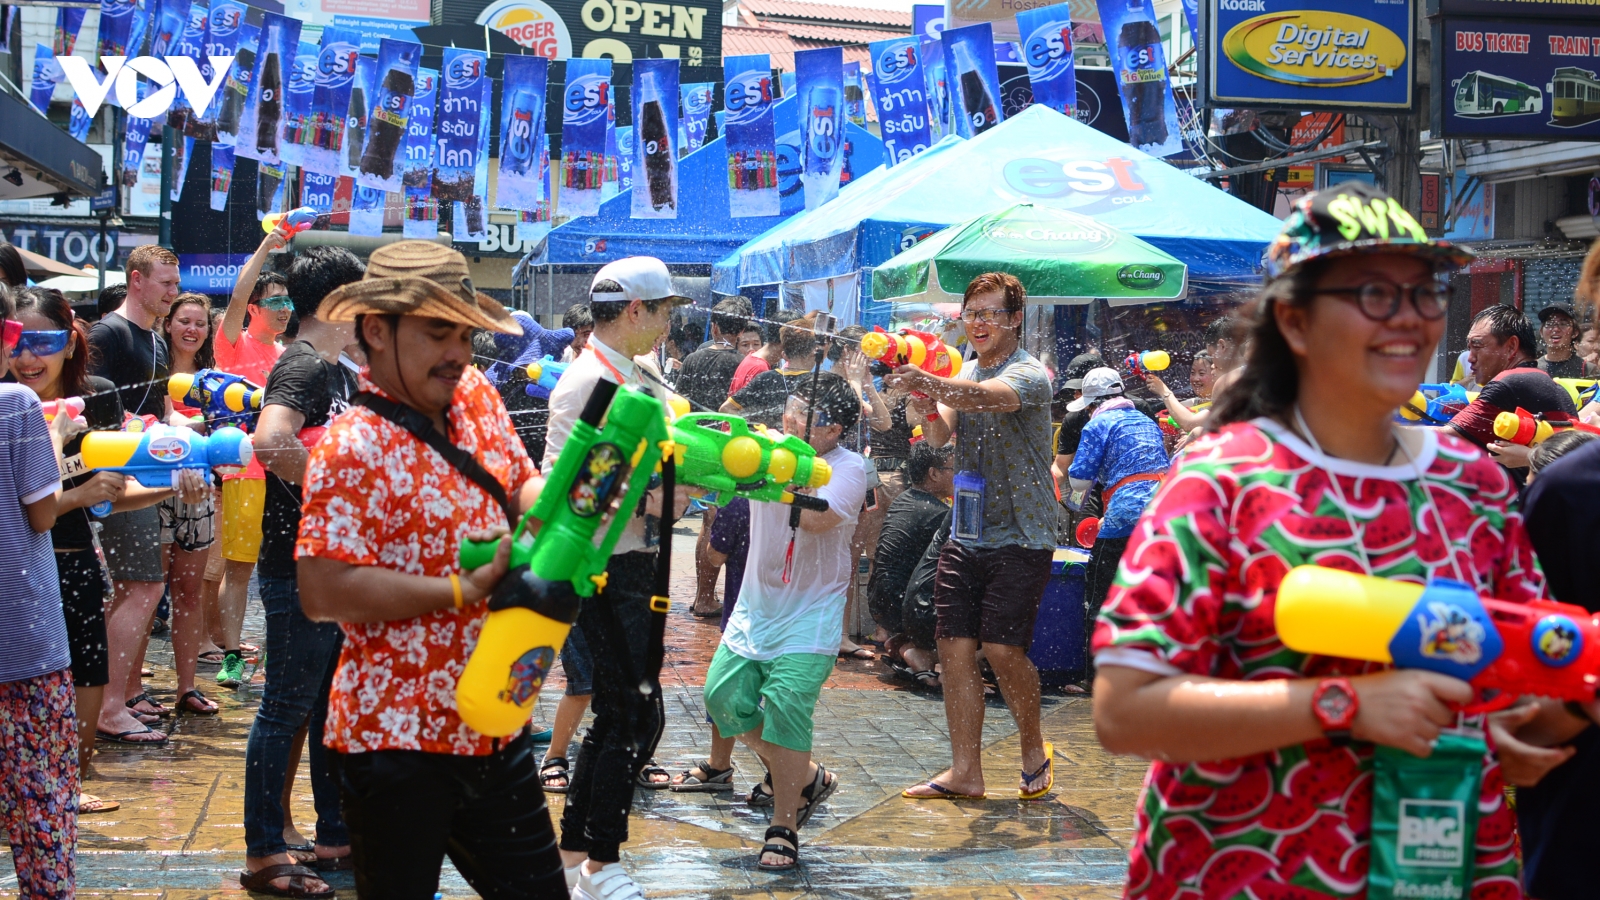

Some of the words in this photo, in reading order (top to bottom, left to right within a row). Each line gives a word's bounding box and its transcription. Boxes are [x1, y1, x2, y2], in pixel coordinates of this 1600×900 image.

[1220, 0, 1266, 12] Kodak
[501, 21, 555, 43] RGER
[581, 0, 707, 39] OPEN
[1027, 26, 1072, 69] est
[1276, 22, 1370, 51] Digital
[1455, 31, 1483, 51] BUS
[1485, 32, 1530, 54] TICKET
[1548, 35, 1590, 56] TRAIN
[318, 48, 357, 75] est
[449, 59, 480, 80] est
[880, 46, 917, 74] est
[1126, 46, 1155, 68] est
[1266, 44, 1379, 69] Services
[290, 60, 318, 82] es
[1140, 73, 1162, 82] Value
[382, 93, 406, 111] est
[566, 81, 608, 112] est
[691, 90, 712, 108] est
[725, 77, 771, 112] est
[510, 107, 532, 160] est
[811, 105, 836, 159] est
[438, 139, 474, 169] โลก
[1003, 156, 1146, 199] est
[1112, 194, 1153, 206] COLA
[1426, 179, 1434, 207] com
[479, 223, 536, 253] BU
[1025, 227, 1103, 243] Chang
[209, 277, 233, 288] EXIT
[1133, 269, 1161, 281] Chang
[1403, 816, 1457, 847] BIG
